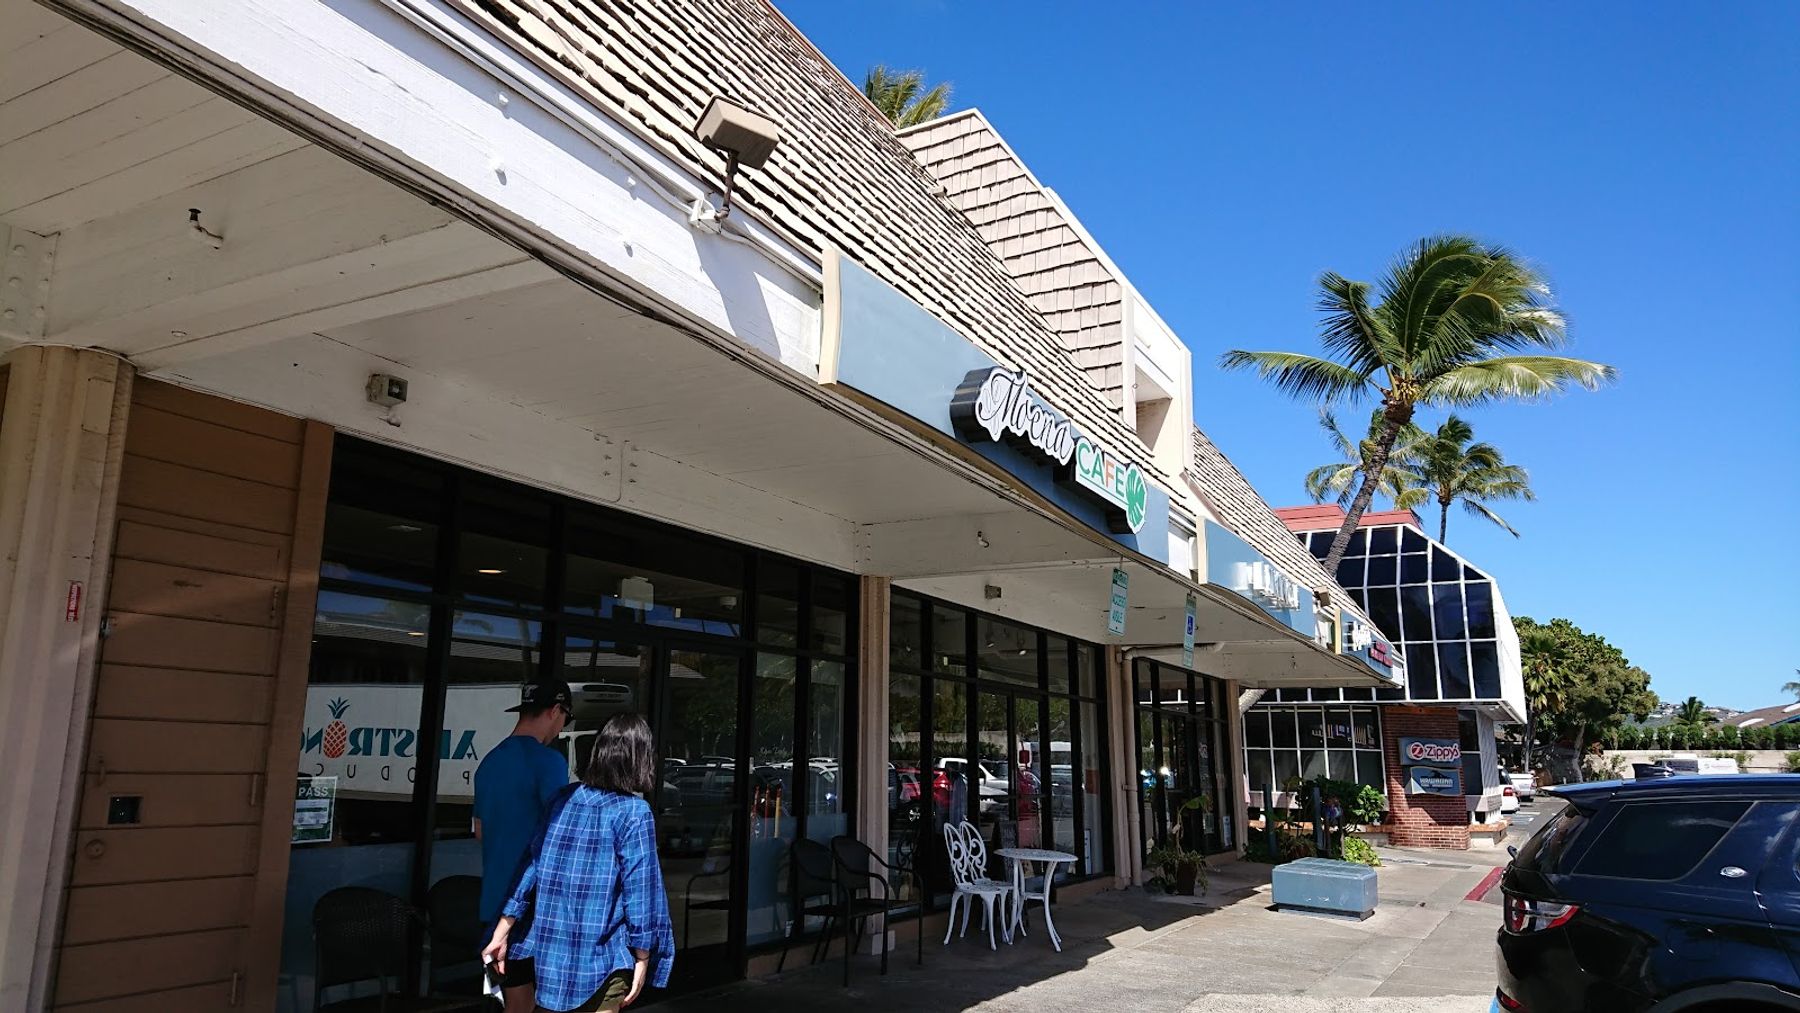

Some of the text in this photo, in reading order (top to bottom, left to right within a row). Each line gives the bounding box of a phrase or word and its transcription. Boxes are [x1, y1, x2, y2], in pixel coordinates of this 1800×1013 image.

[978, 371, 1072, 461] Moena
[1077, 441, 1126, 498] CAFE
[298, 786, 329, 797] PASS
